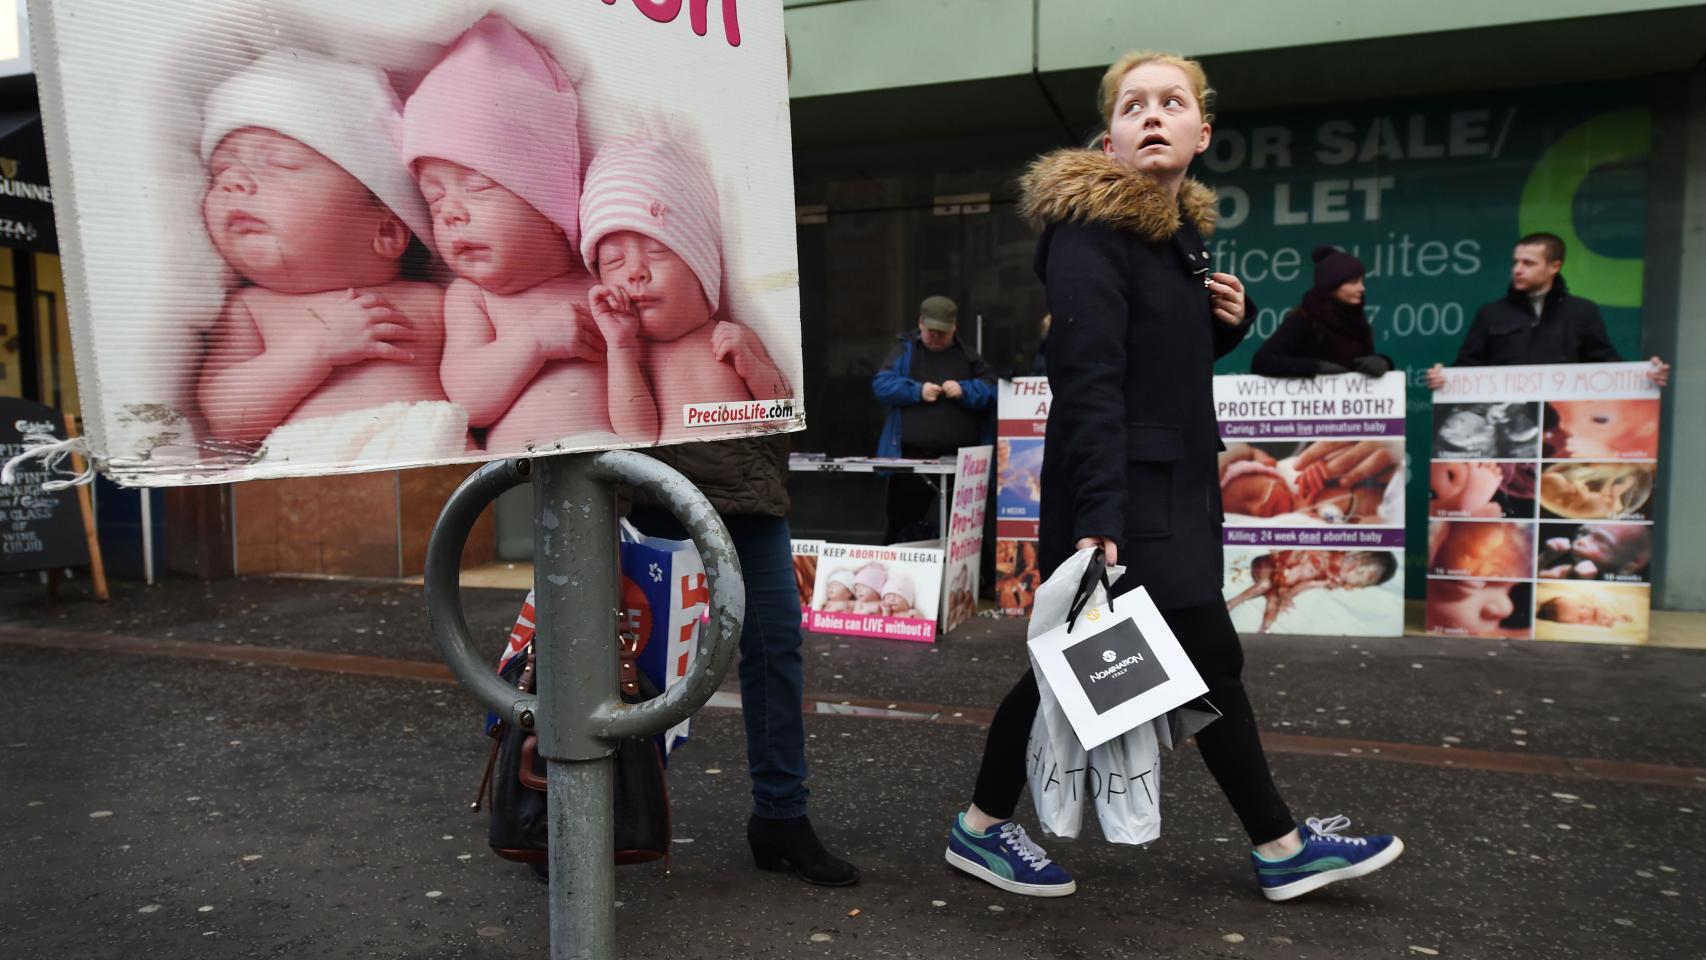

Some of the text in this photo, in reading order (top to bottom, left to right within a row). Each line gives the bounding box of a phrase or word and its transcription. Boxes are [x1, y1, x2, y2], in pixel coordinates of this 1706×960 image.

[1202, 106, 1517, 173] OR SALE/
[1215, 176, 1396, 230] O LET
[1211, 232, 1482, 284] fice uites
[1013, 381, 1048, 395] THE
[1237, 376, 1375, 396] WHY CAN'T WE
[1503, 371, 1545, 394] FIRST
[1552, 371, 1566, 390] 9
[688, 403, 793, 424] PreciousLife.com
[1218, 401, 1285, 418] PROTECT
[1291, 399, 1336, 416] THEM
[1342, 398, 1394, 415] BOTH?
[1226, 421, 1386, 435] Caring: 24 week live premature baby
[963, 453, 988, 478] Please
[1228, 531, 1383, 544] Killing: 24 week dead aborted baby
[792, 544, 819, 554] LEGAL
[823, 547, 938, 564] KEEP ABORTION ILLEGAL
[813, 613, 932, 637] Babies can LIVE without it
[1111, 668, 1128, 679] ITALY
